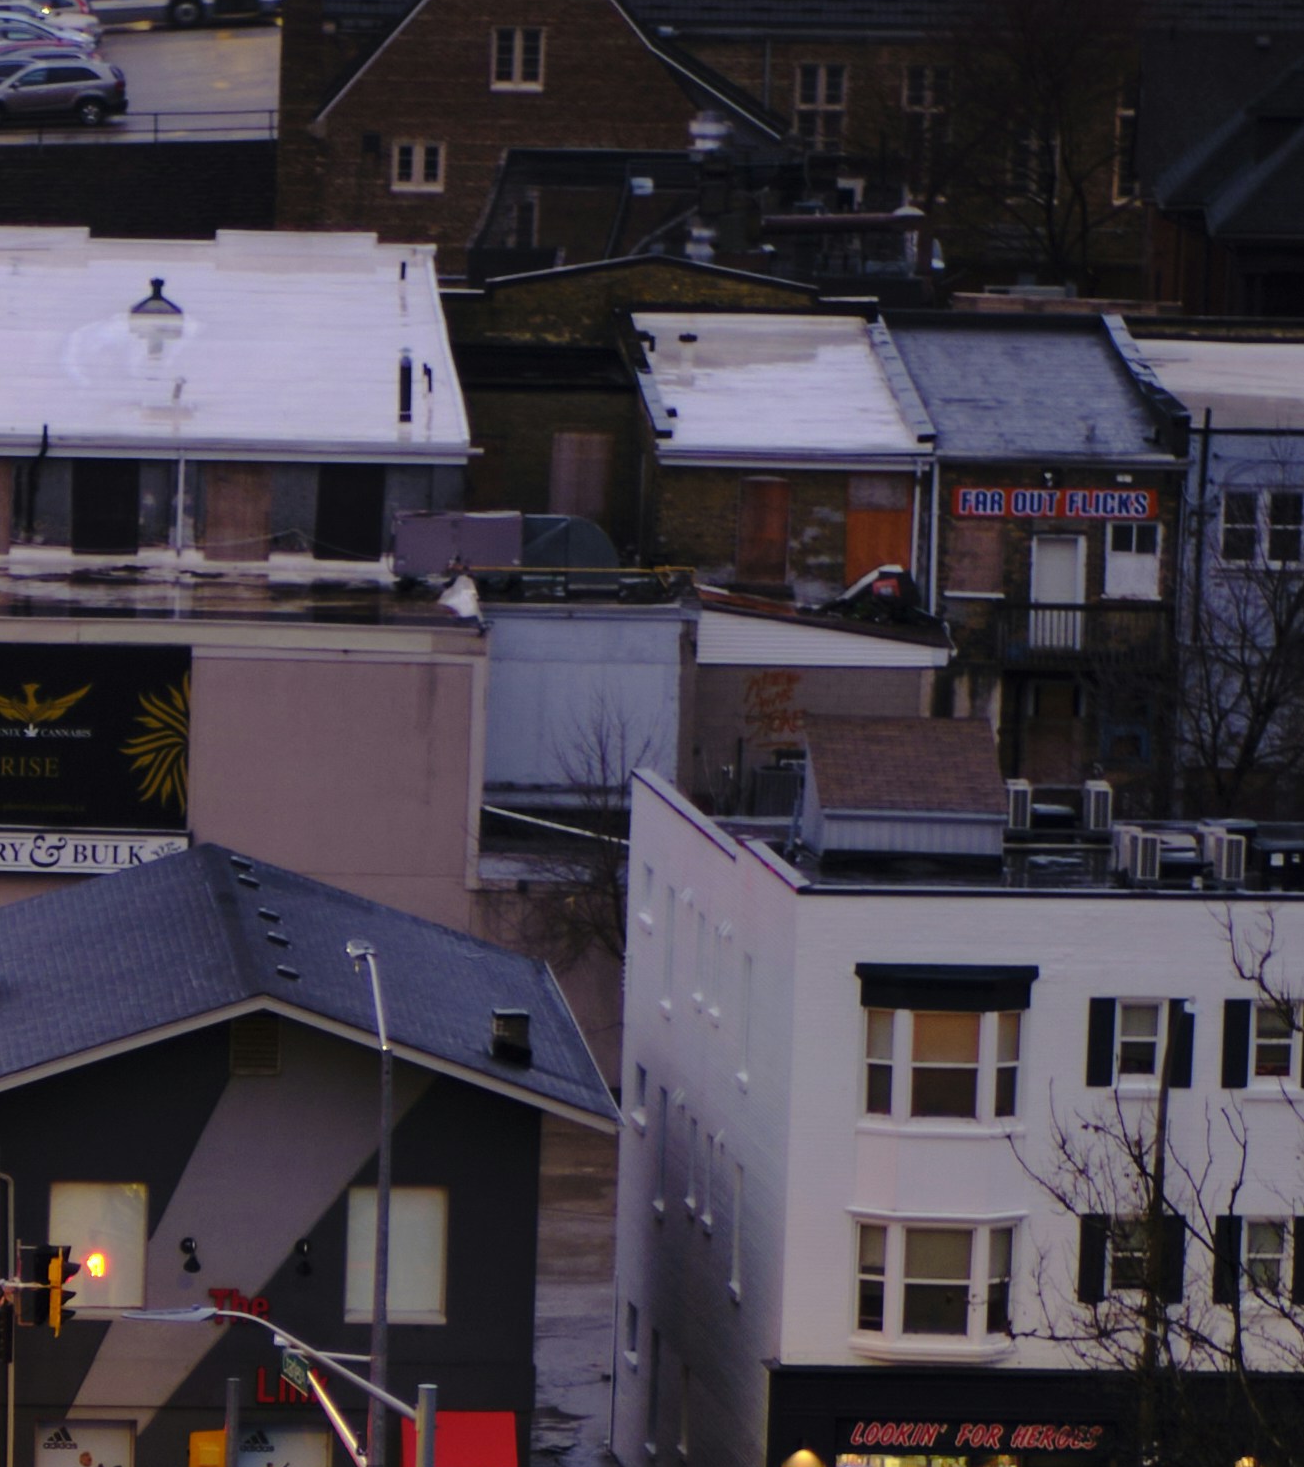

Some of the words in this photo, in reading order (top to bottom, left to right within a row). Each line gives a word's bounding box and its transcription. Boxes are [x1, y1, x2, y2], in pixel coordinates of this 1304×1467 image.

[959, 489, 1005, 514] FAR
[1012, 489, 1060, 516] OUT
[1066, 490, 1150, 517] FLICKS
[40, 729, 92, 739] CANNABIS
[0, 756, 60, 778] RISE
[29, 835, 68, 868] &
[73, 844, 145, 865] BULK
[208, 1288, 270, 1325] The
[43, 1440, 78, 1450] adidas
[240, 1443, 275, 1453] adidas
[850, 1421, 948, 1448] LOOKIN'
[954, 1422, 1005, 1450] FOR
[1010, 1423, 1104, 1451] HEROES
